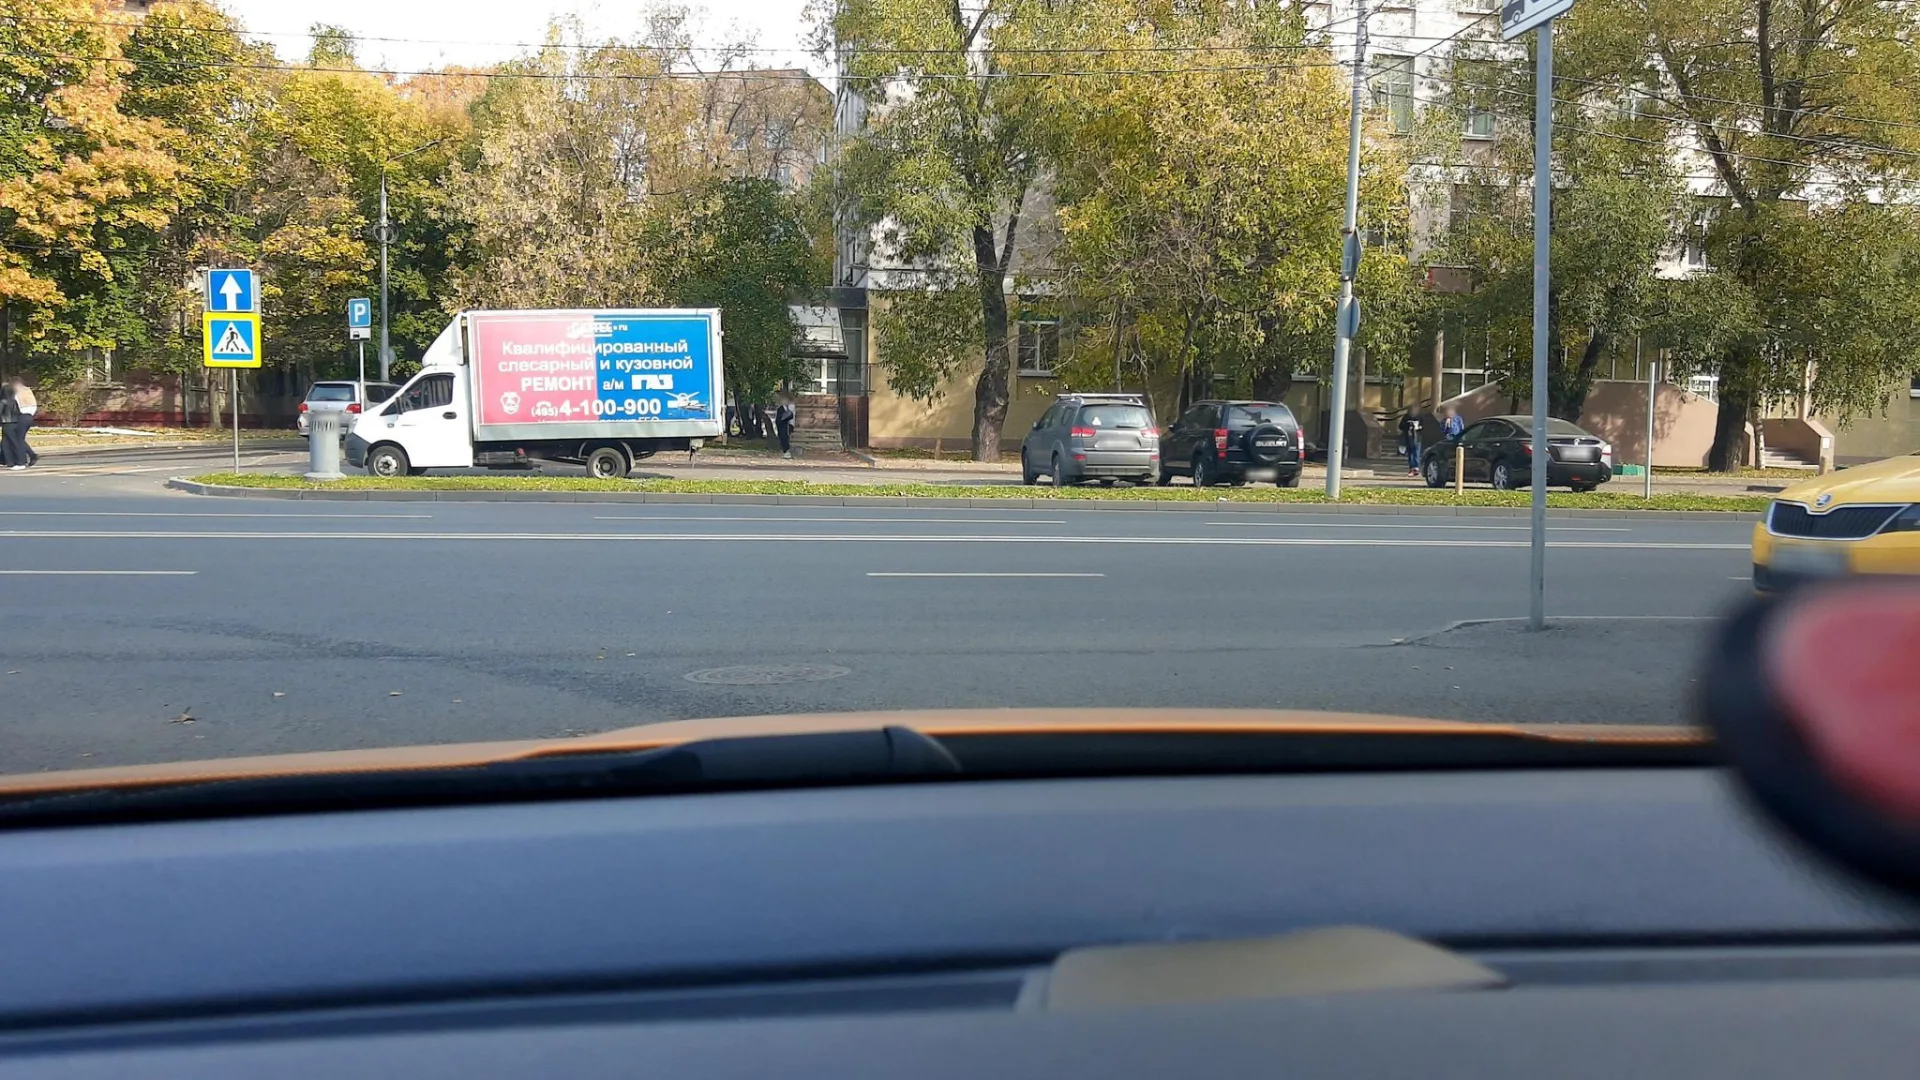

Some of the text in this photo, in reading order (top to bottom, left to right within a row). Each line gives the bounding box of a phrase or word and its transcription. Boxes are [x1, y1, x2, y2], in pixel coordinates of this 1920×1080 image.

[354, 303, 366, 323] P
[502, 340, 688, 357] Квалифицированный
[498, 356, 693, 374] слесарный и кузовной
[521, 374, 674, 392] РЕМОНТ а/м ГАЗ
[559, 398, 662, 416] 4-100-900
